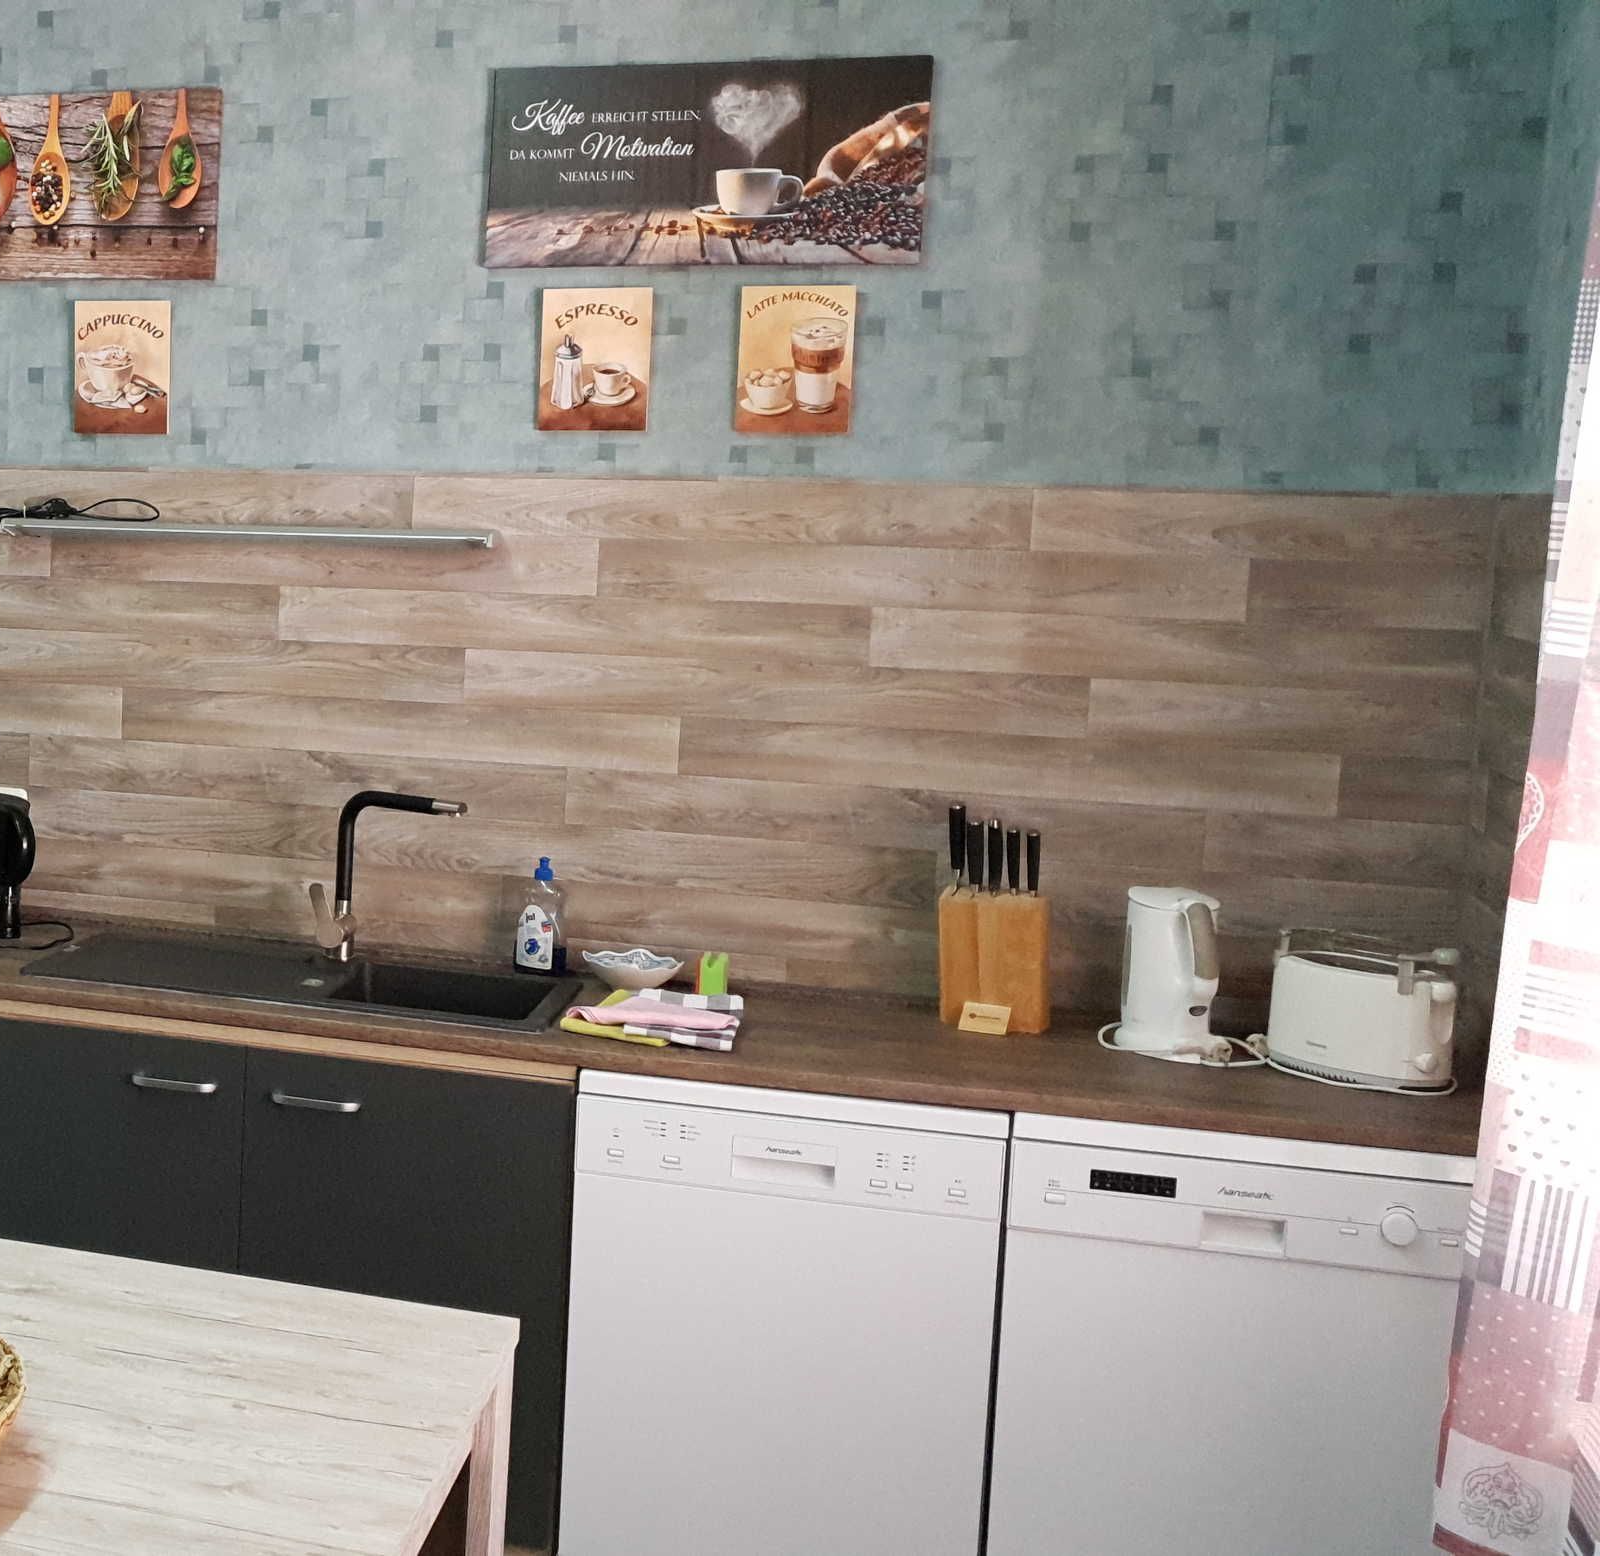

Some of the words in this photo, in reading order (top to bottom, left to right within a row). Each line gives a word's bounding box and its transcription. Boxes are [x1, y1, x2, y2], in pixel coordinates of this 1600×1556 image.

[511, 98, 585, 136] Kaffee
[591, 111, 649, 124] ERREICHT
[509, 149, 526, 161] DA
[529, 148, 575, 160] KOMMT
[580, 131, 695, 161] Motivation
[558, 170, 608, 183] NIEMALS
[554, 303, 639, 329] ESPRESSO
[746, 295, 778, 319] LATTE
[781, 291, 849, 317] MACCHIATO
[77, 312, 165, 341] CAPPUCCINO
